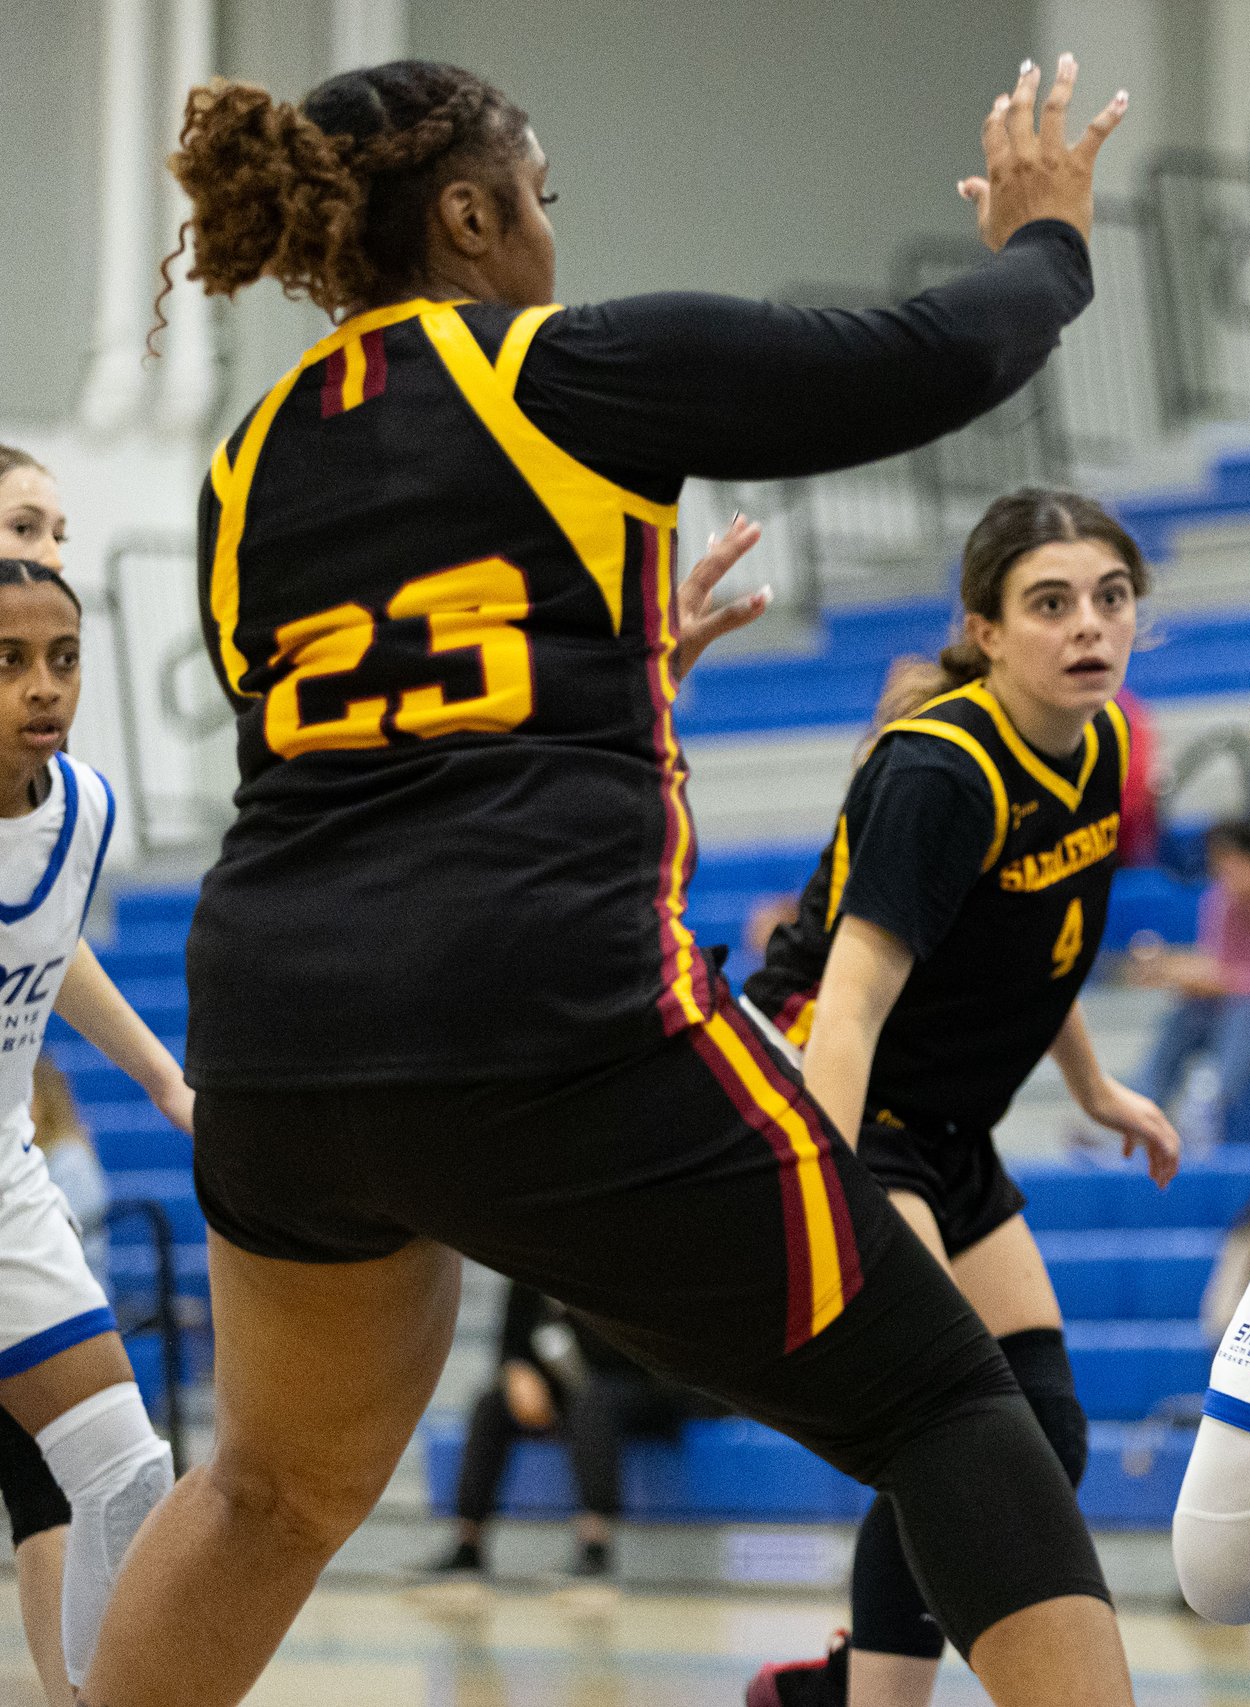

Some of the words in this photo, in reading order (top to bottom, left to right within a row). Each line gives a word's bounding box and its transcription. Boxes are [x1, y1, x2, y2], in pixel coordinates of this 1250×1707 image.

[264, 553, 532, 761] 23
[1051, 896, 1084, 980] 4
[0, 956, 65, 1006] MC
